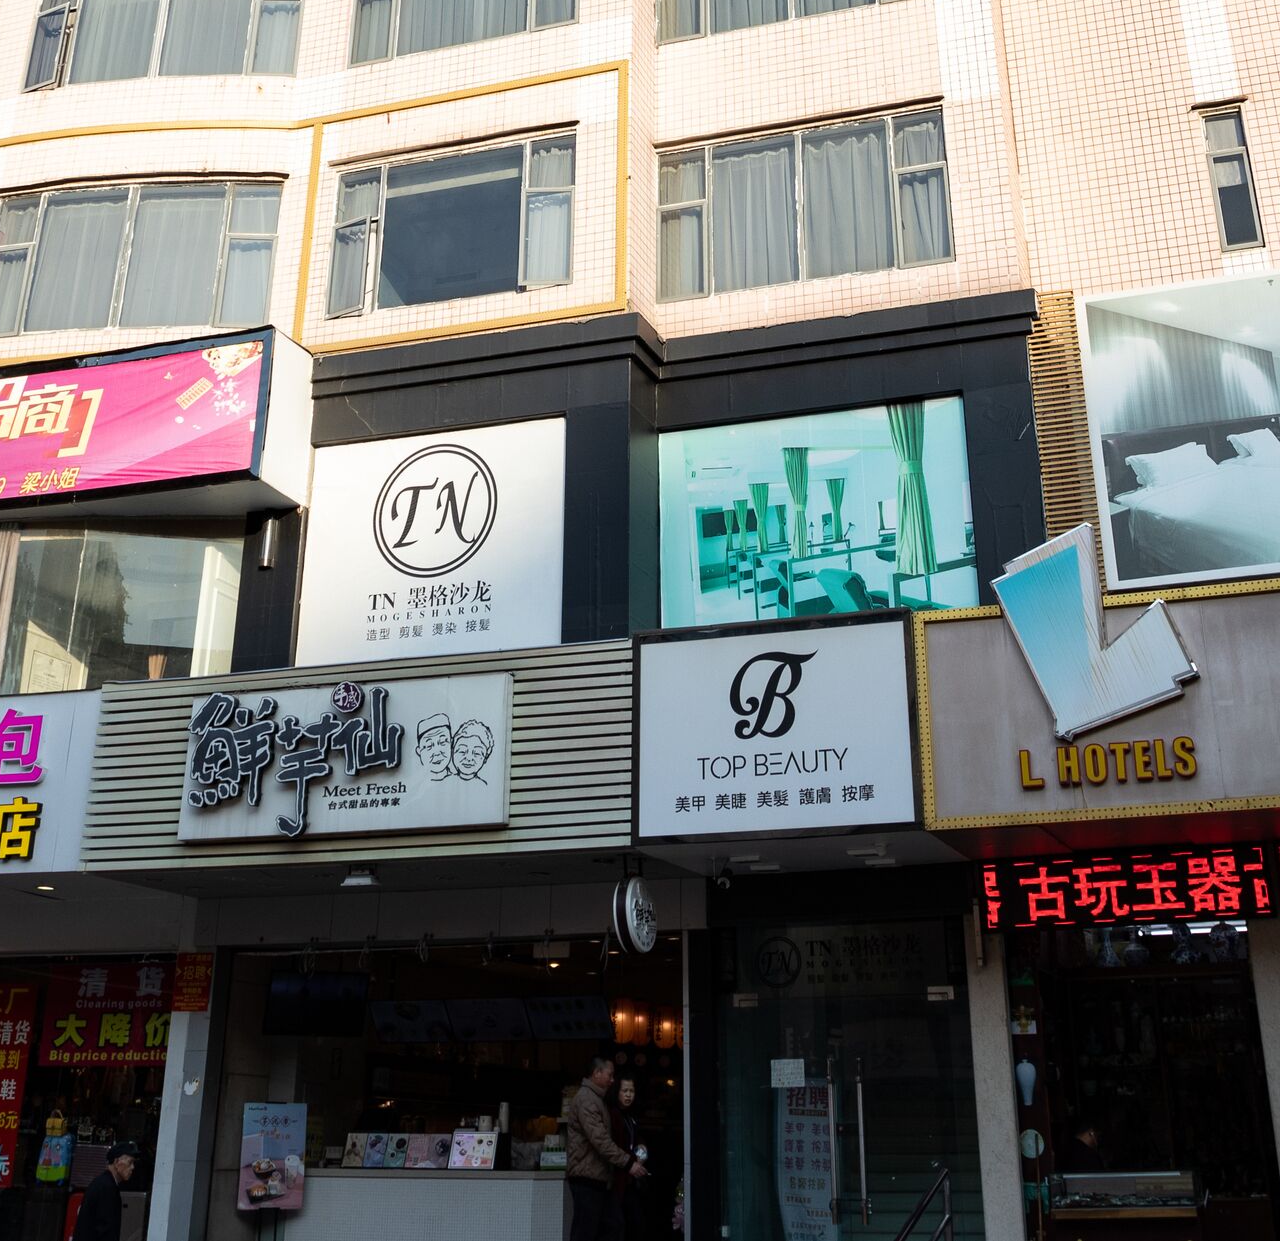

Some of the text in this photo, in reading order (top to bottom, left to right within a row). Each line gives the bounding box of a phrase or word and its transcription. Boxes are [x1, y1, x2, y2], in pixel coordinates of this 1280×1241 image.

[19, 467, 80, 494] 梁小姐
[391, 471, 478, 549] TN
[368, 580, 492, 610] TN 墨格沙龙
[366, 627, 391, 641] 造型
[697, 747, 849, 780] TOP BEAUTY
[1019, 735, 1198, 790] L HOTELS
[322, 781, 407, 798] Meet Fresh
[328, 797, 401, 810] 台式甜品的專家
[675, 795, 706, 813] 美甲
[715, 792, 747, 811] 美睫
[798, 786, 831, 806] 護膚
[842, 784, 875, 803] 按摩
[77, 967, 165, 999] 清货
[76, 998, 163, 1010] Clearing goods
[53, 1011, 171, 1048] 大降价
[49, 1049, 168, 1063] Big price reductio
[787, 1085, 830, 1109] 招聘
